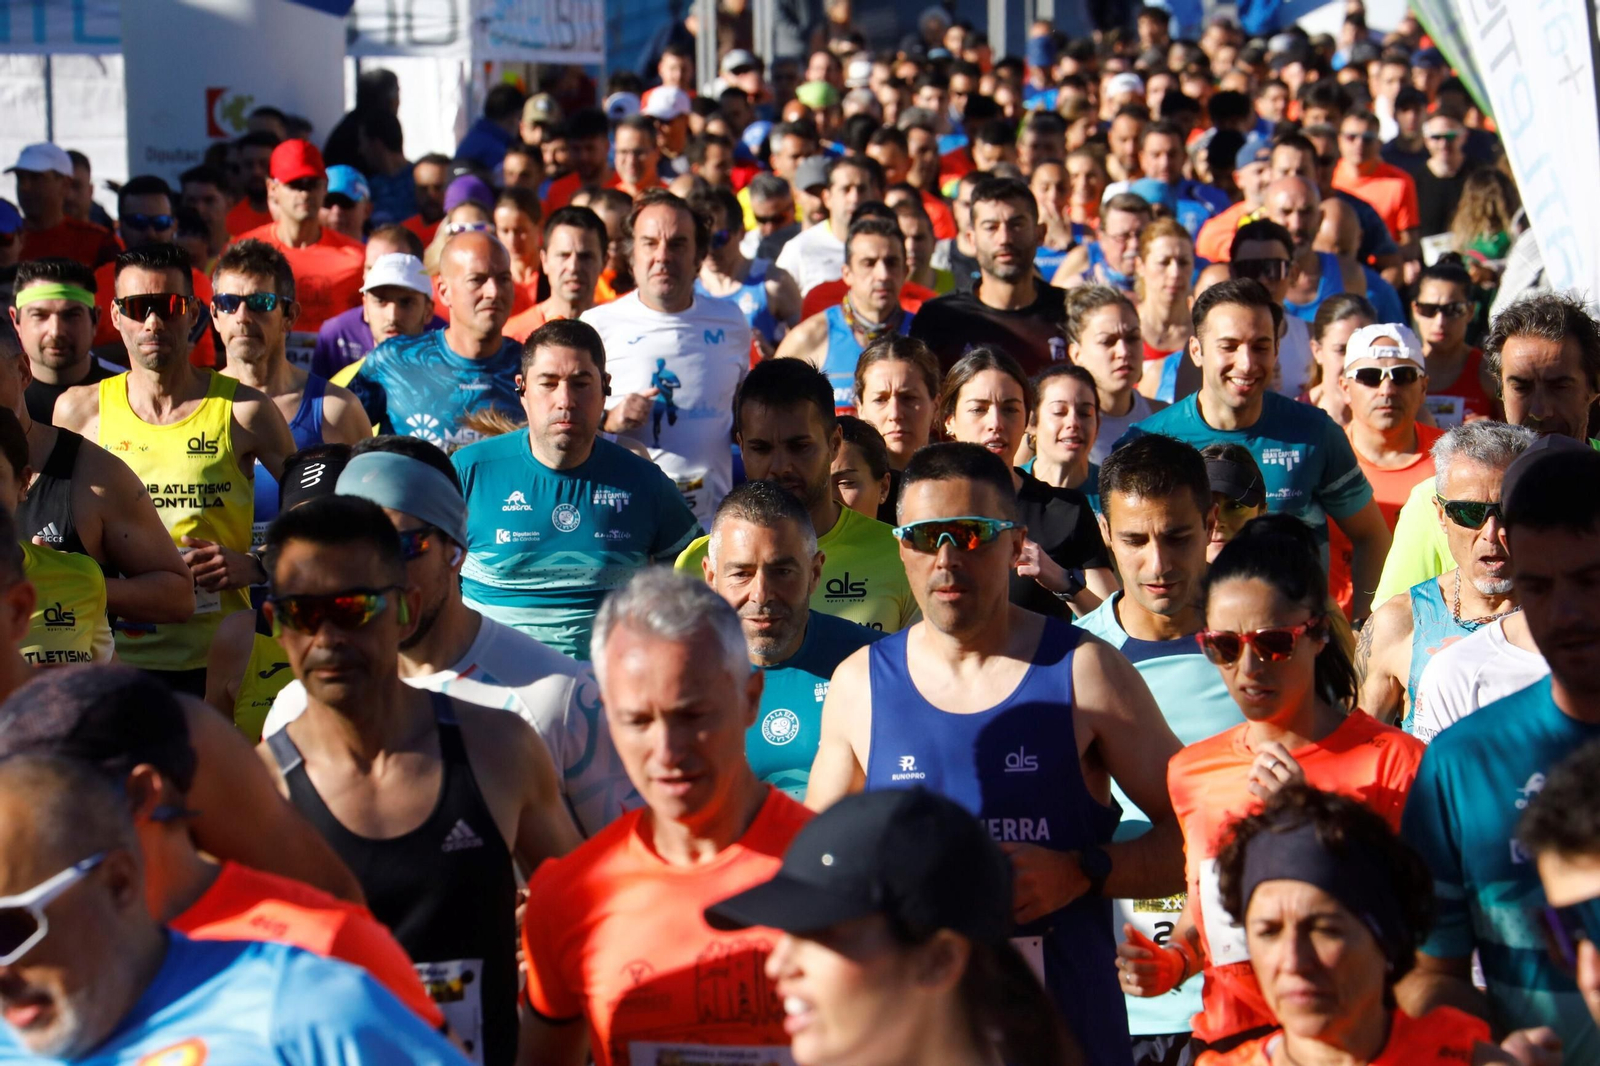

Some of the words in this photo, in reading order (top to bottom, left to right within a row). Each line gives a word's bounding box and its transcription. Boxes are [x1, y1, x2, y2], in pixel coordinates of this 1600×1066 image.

[186, 431, 219, 455] als
[163, 481, 232, 494] ATLETISMO
[512, 530, 540, 539] Diputación
[824, 571, 868, 599] als
[44, 602, 75, 627] als
[1004, 745, 1039, 773] als
[982, 817, 1050, 842] ERRA
